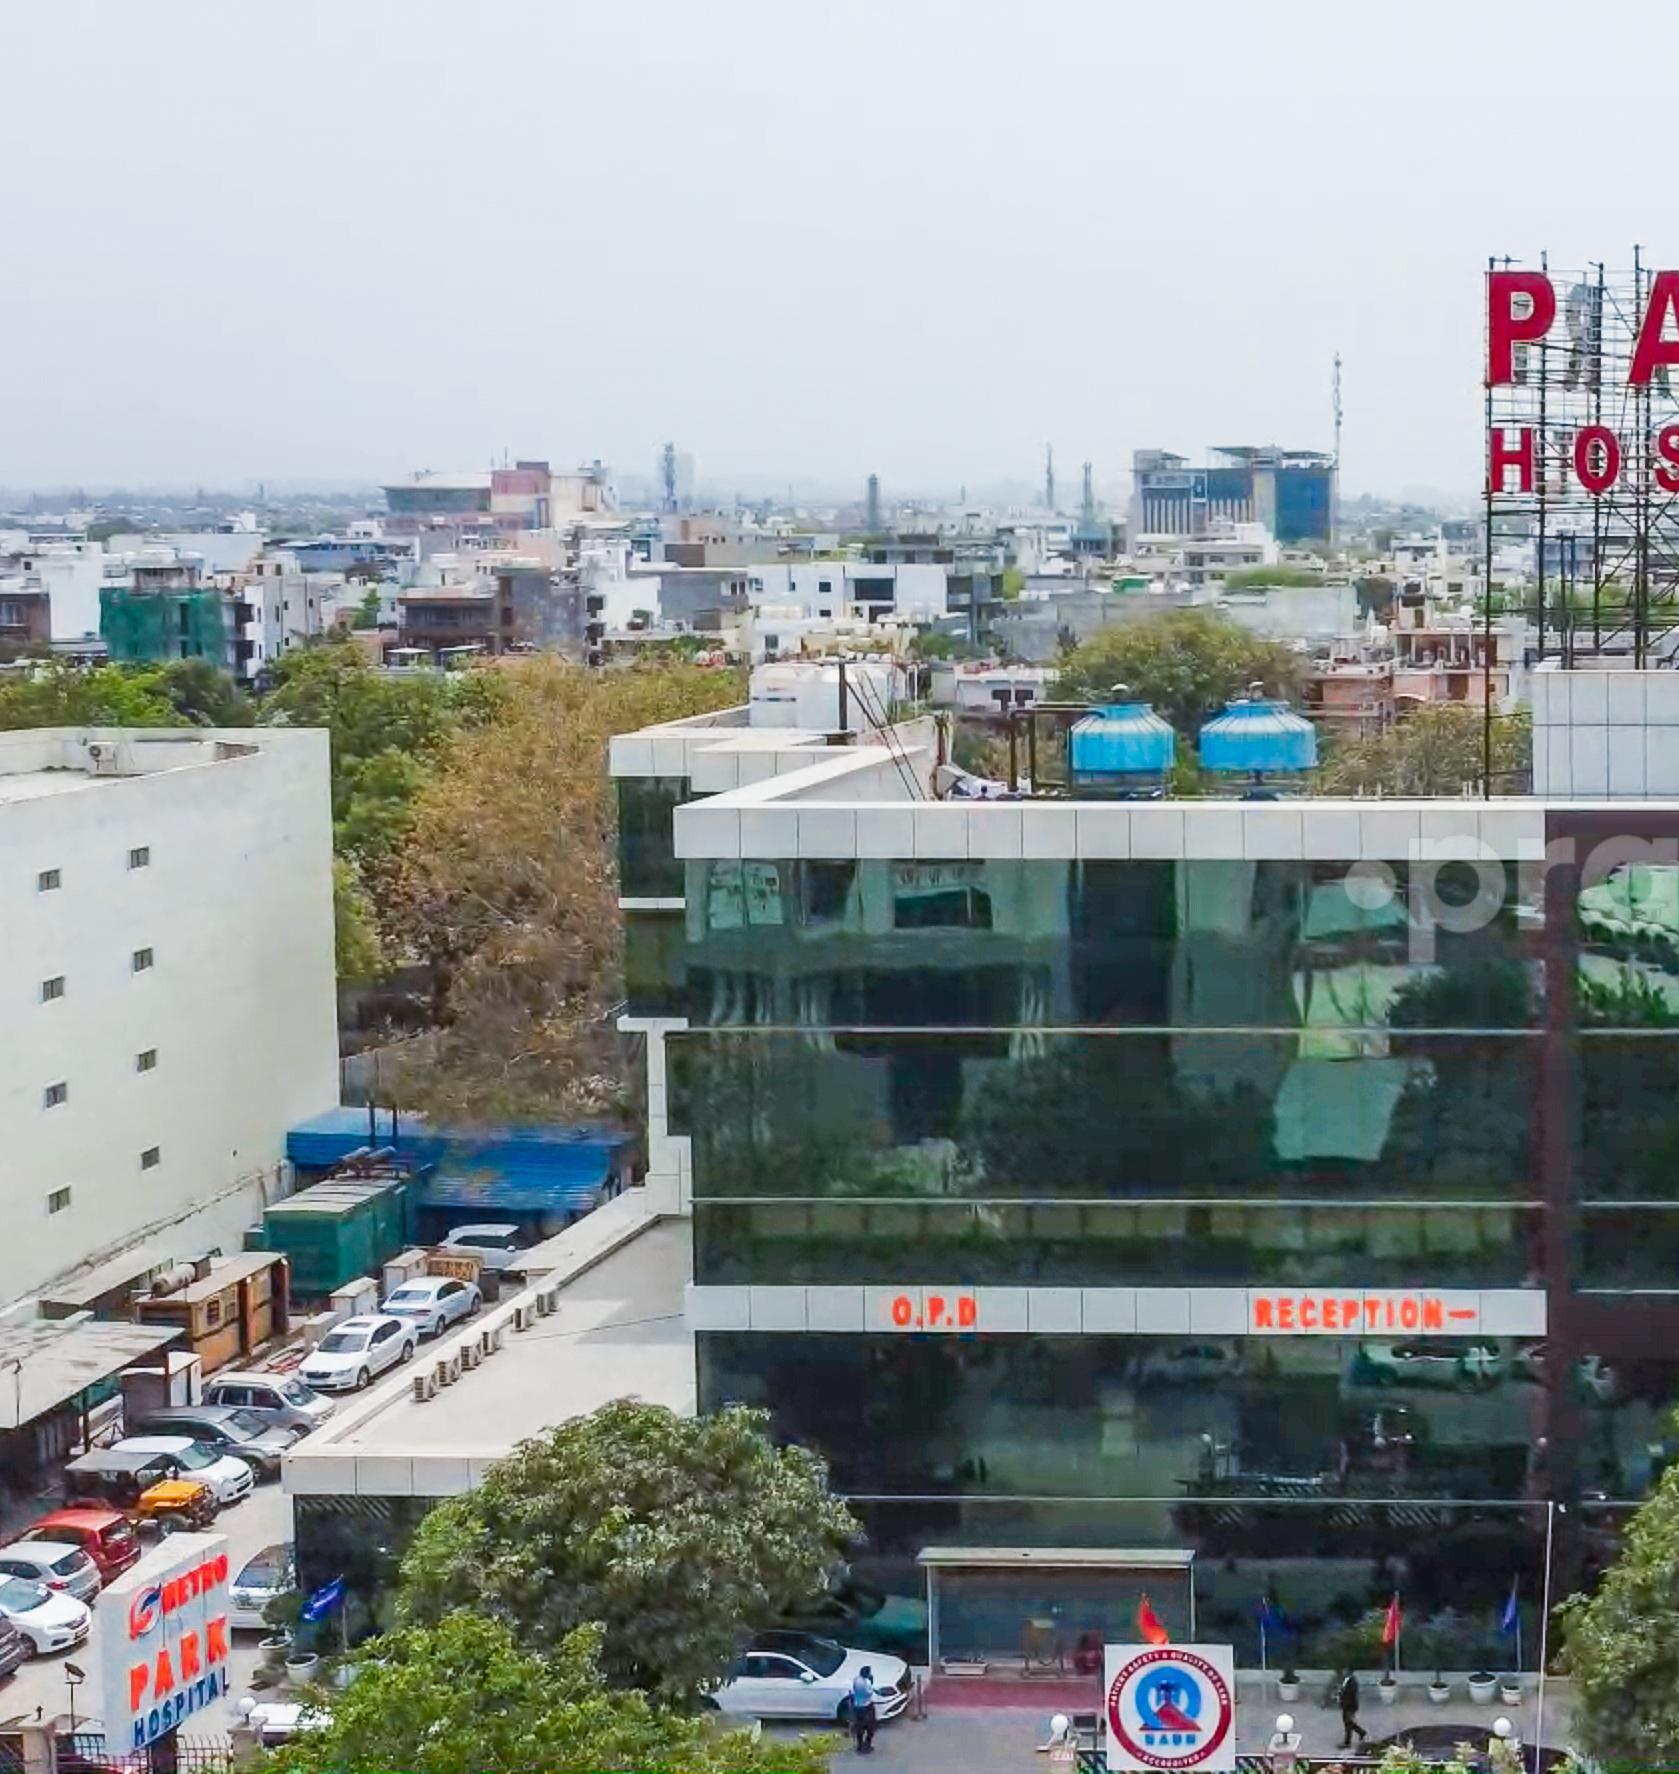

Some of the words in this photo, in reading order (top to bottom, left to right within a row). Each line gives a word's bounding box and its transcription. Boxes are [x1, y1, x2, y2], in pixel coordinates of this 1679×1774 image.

[162, 1553, 228, 1615] METRO
[130, 1616, 229, 1713] PARK
[134, 1667, 229, 1747] HOSPITAL
